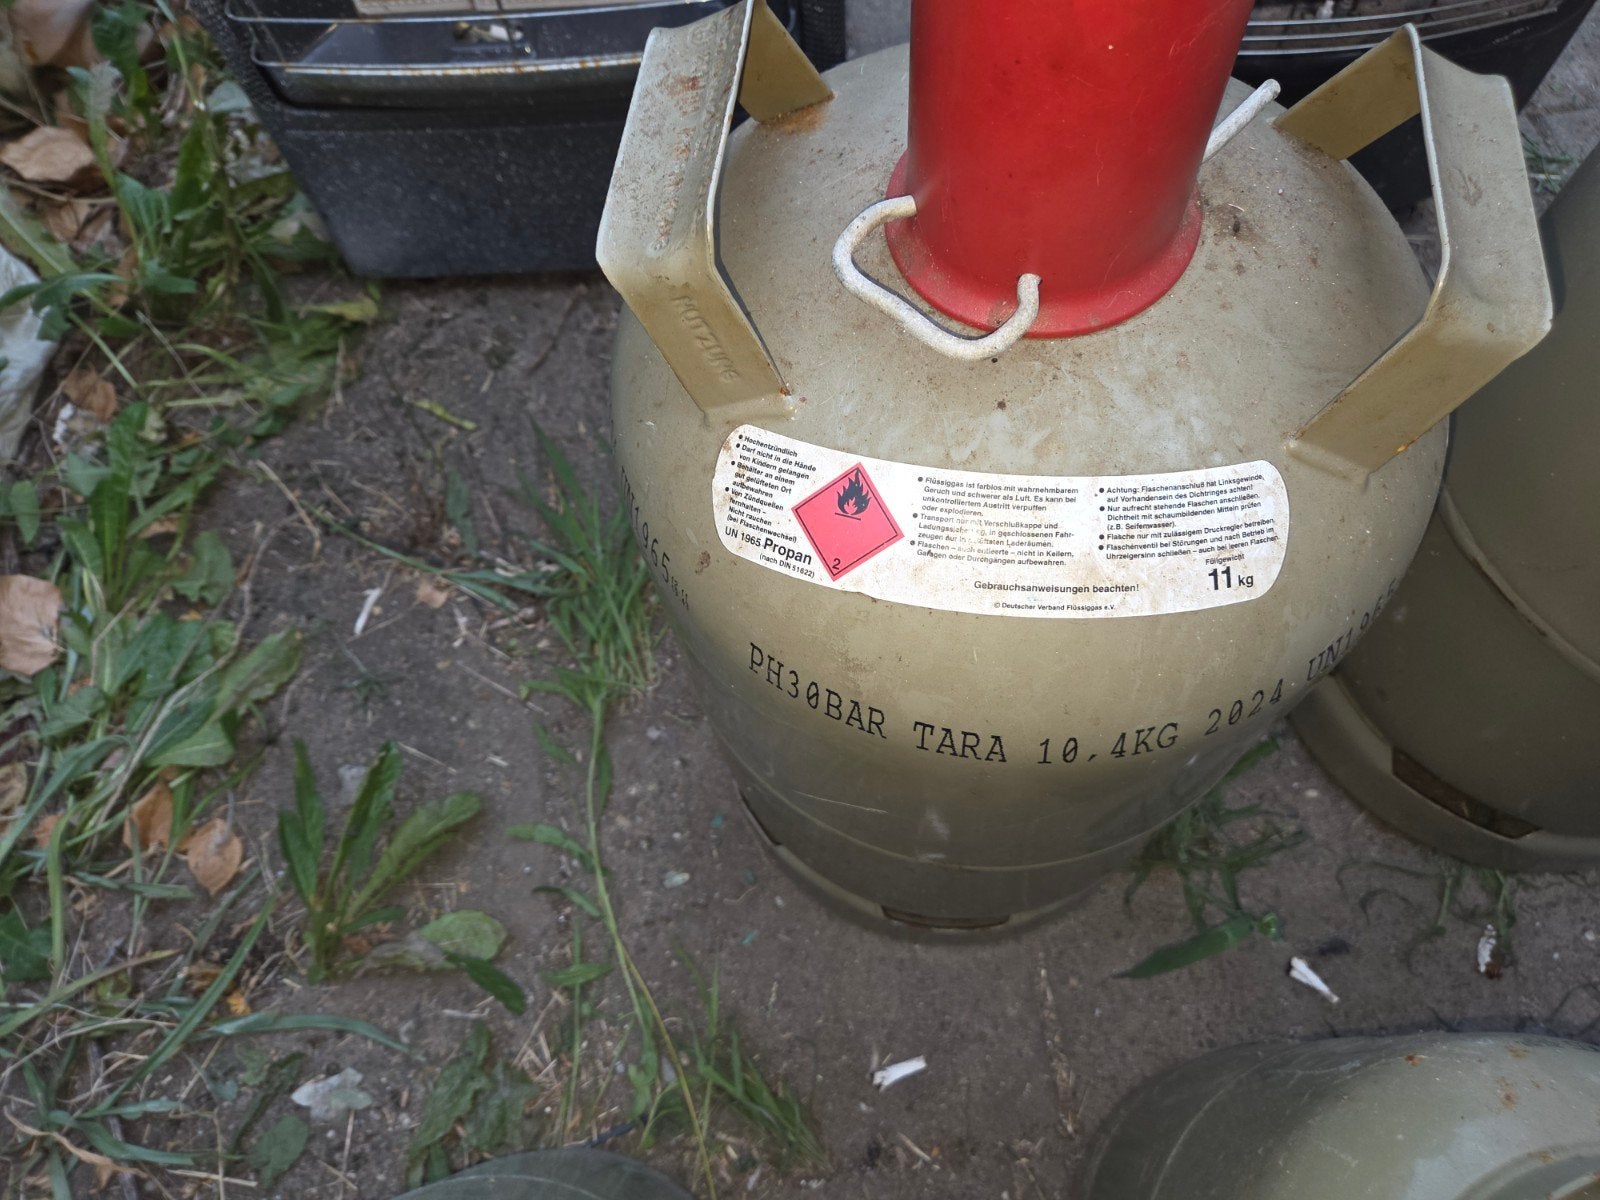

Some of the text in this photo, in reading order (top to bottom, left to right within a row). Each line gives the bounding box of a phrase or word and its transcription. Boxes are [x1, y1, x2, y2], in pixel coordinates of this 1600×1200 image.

[725, 526, 812, 565] UN 1965 Propan
[760, 553, 815, 578] (nach DIN 51622)
[832, 558, 841, 570] 2
[974, 581, 1140, 594] Gebrauchsanweisungen beachten!
[1208, 566, 1254, 590] 11 kg
[749, 642, 887, 739] PH30BAR
[913, 721, 1007, 763] TARA
[1038, 722, 1178, 764] 10,4KG
[1204, 679, 1283, 736] 2024
